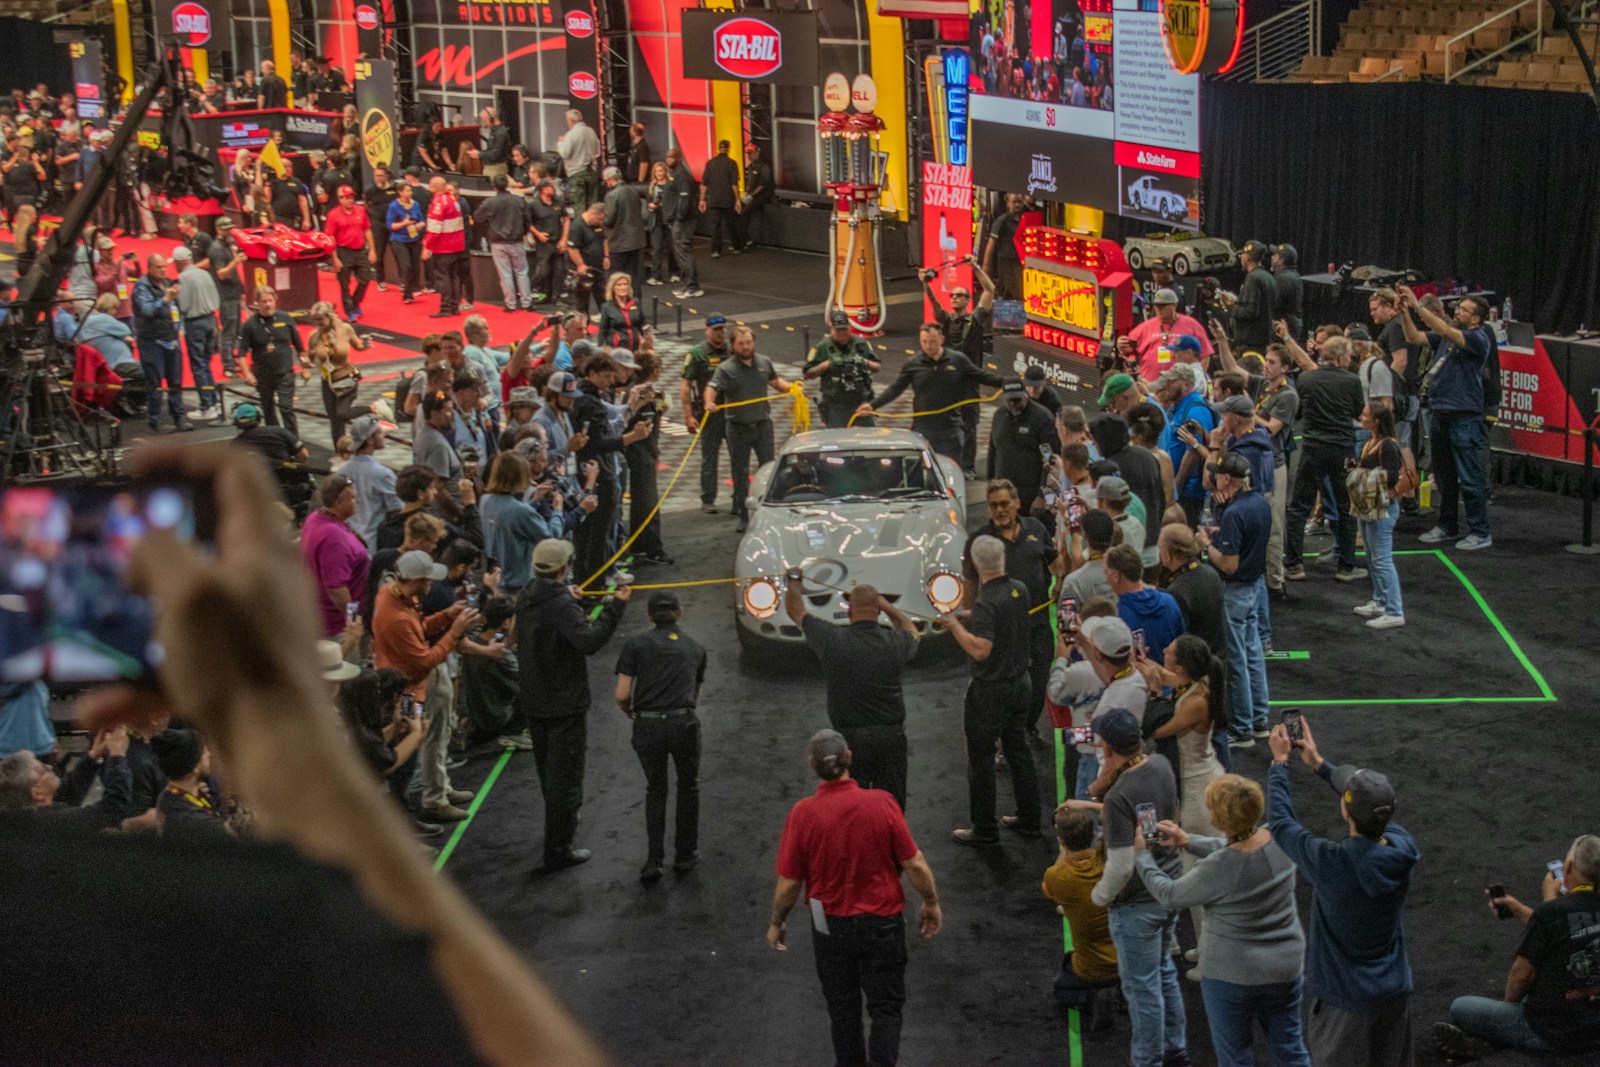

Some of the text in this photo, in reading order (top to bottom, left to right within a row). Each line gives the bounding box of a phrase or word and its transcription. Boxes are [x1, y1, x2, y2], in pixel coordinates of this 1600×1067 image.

[175, 14, 209, 34] STA-BIL
[567, 17, 592, 30] STA-BIL
[719, 34, 777, 61] STA-BIL
[570, 78, 596, 92] STA-BIL
[945, 55, 966, 165] MECU
[1046, 107, 1056, 127] $0
[923, 163, 972, 188] STA-BIL
[923, 183, 972, 211] STA-BIL
[1023, 323, 1097, 359] AUCTIONS
[1512, 370, 1539, 392] BIDS
[1511, 391, 1533, 412] FOR
